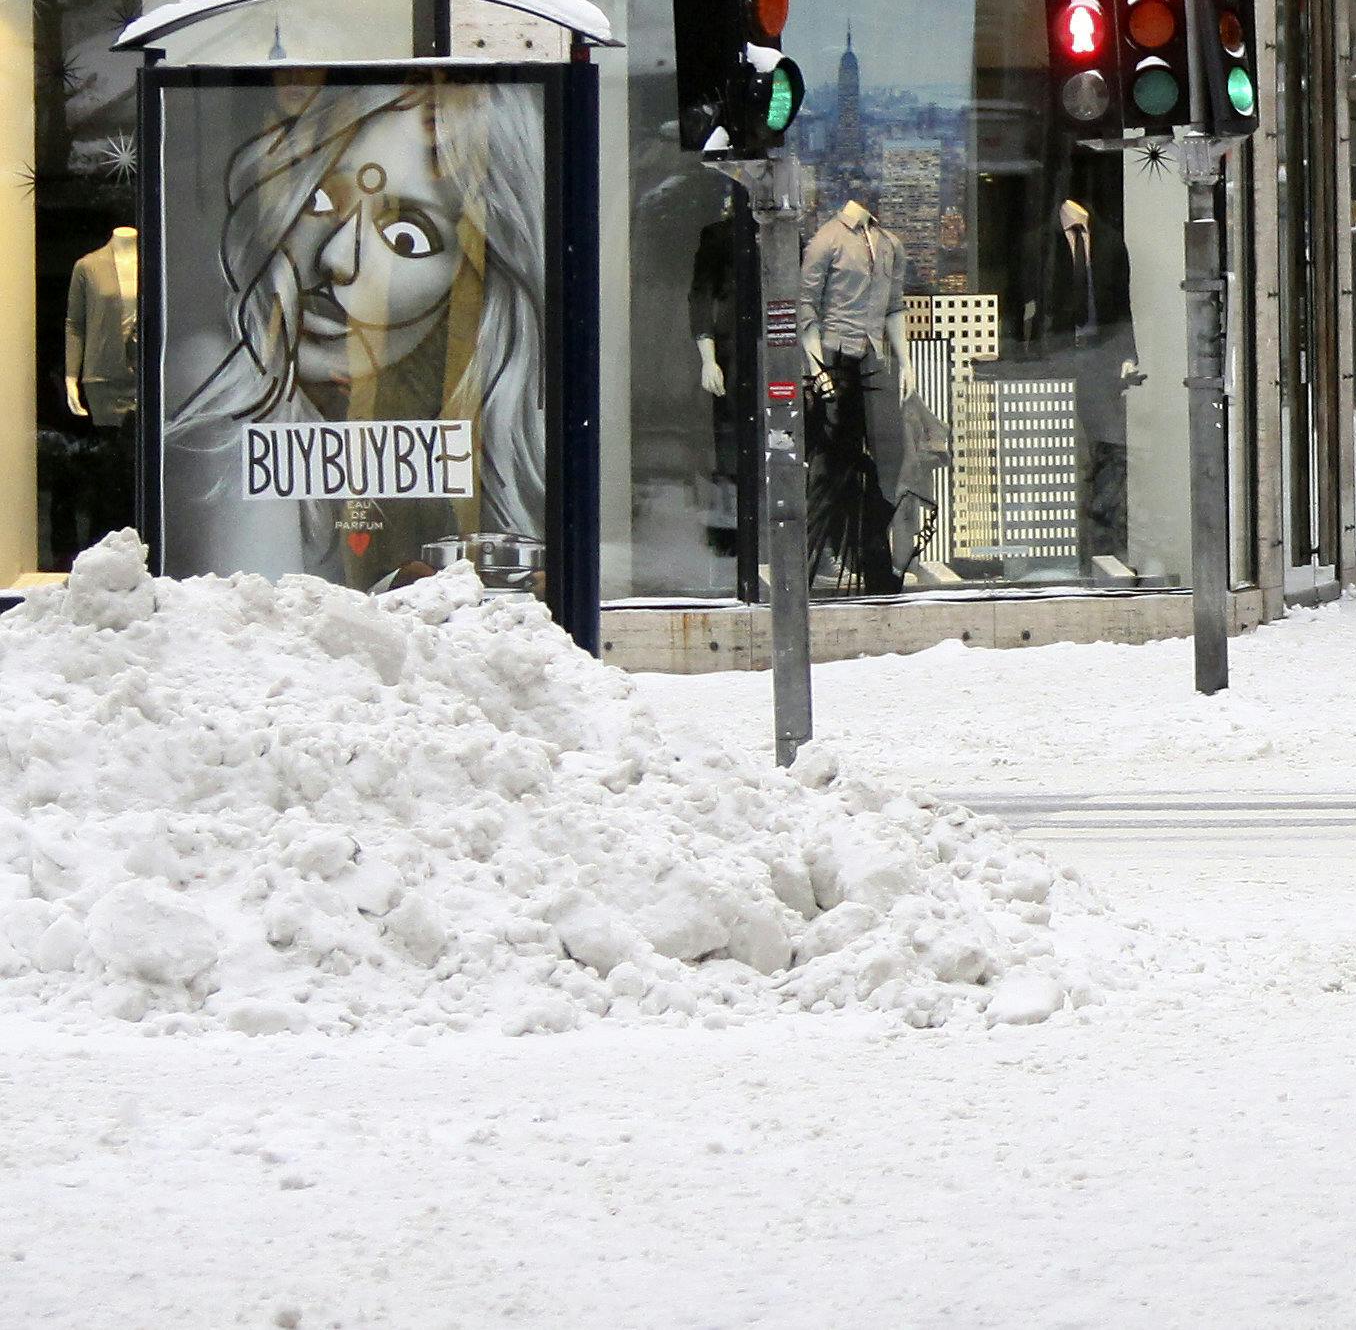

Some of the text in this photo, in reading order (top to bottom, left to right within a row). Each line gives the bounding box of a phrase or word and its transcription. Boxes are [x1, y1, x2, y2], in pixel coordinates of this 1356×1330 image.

[247, 424, 473, 498] BUYBUYBYE
[347, 500, 371, 510] EAU
[351, 511, 366, 520] DE
[334, 521, 383, 531] PARFUM
